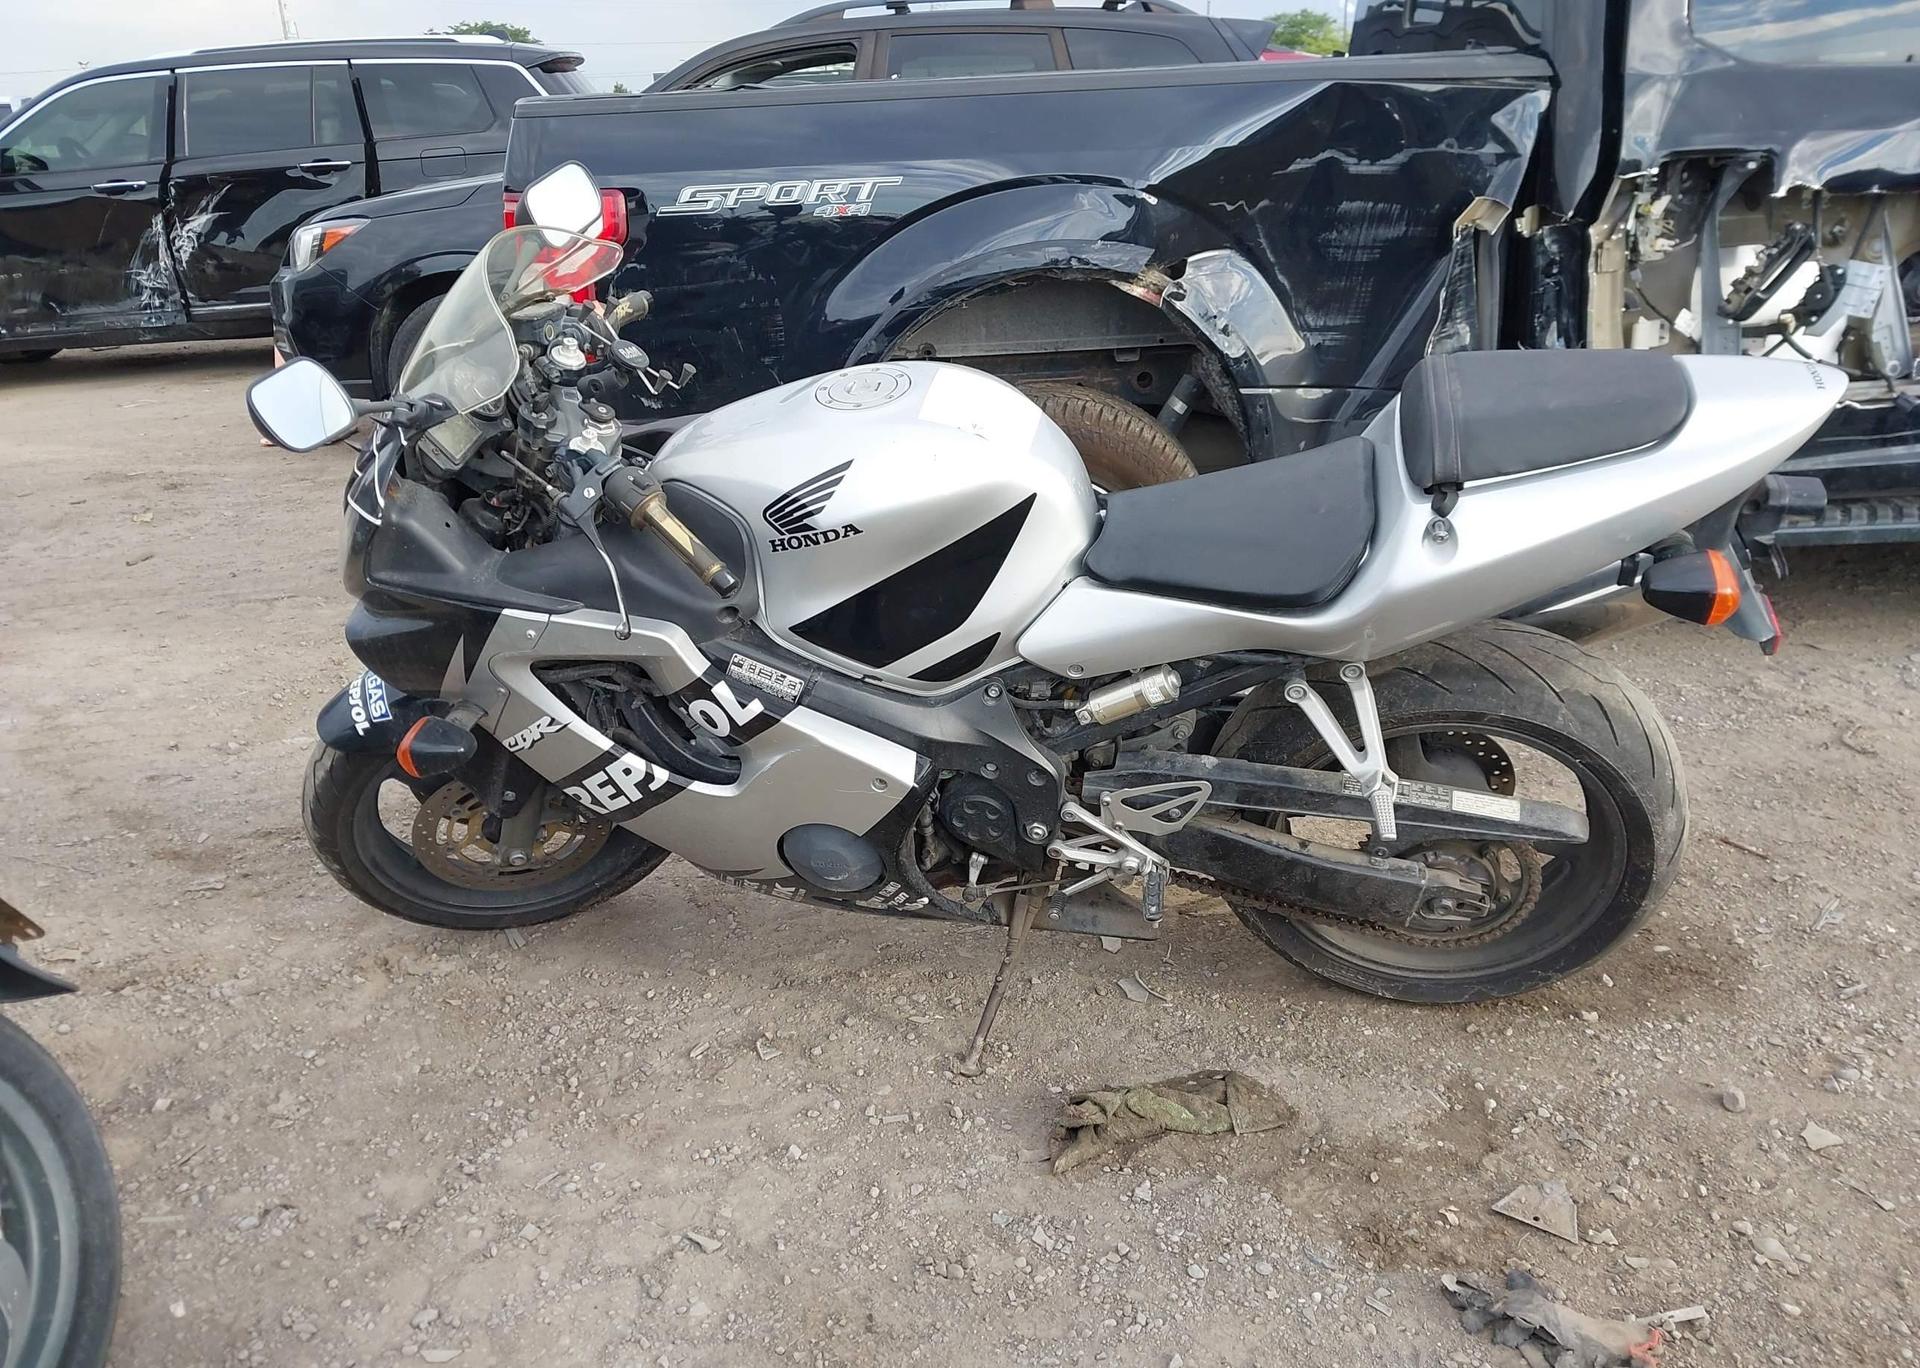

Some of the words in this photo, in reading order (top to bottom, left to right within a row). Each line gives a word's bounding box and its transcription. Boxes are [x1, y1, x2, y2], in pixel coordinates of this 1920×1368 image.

[656, 176, 903, 216] SPORT
[768, 523, 864, 553] HONDA
[348, 675, 370, 736] EPSOL
[367, 676, 387, 718] GAS
[502, 715, 574, 753] CBR
